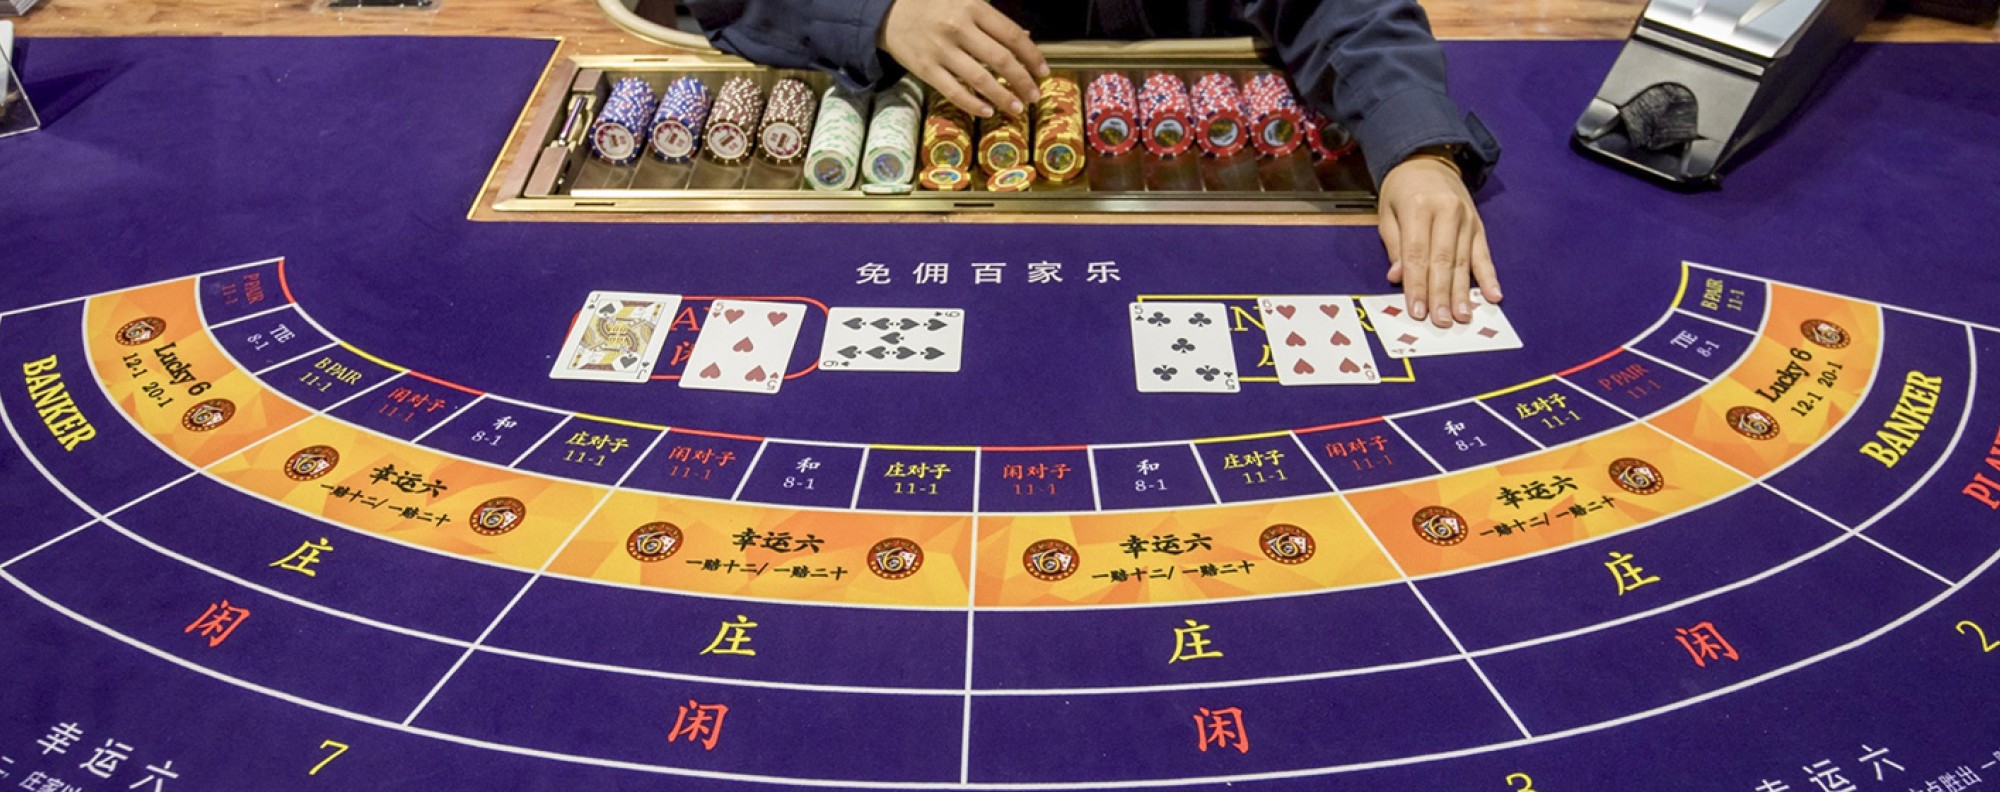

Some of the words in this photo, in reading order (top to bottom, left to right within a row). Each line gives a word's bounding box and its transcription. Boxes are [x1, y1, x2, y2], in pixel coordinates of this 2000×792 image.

[856, 261, 1122, 285] 免佣百家乐
[1702, 278, 1724, 303] PAIR
[1727, 289, 1745, 311] 11-1
[1134, 305, 1144, 315] 5
[247, 333, 269, 351] 8-1
[269, 323, 296, 344] TIE
[1669, 330, 1698, 349] TIE
[1696, 340, 1721, 358] 8-1
[122, 352, 149, 379] 12-1
[142, 381, 174, 408] 20-1
[153, 342, 197, 386] Lucky
[187, 381, 212, 397] 6
[299, 371, 332, 392] 11-1
[314, 356, 333, 370] B
[324, 361, 362, 386] PAIR
[1610, 363, 1649, 387] PAIR
[1755, 359, 1811, 404] Lucky
[1790, 347, 1813, 362] 6
[1225, 379, 1236, 390] 5
[1791, 392, 1823, 418] 12-1
[1818, 361, 1844, 388] 20-1
[23, 354, 97, 453] BANKER
[387, 386, 446, 413] 闲对子
[1515, 392, 1567, 419] 庄对子
[492, 416, 518, 430] 和
[1443, 420, 1467, 438] 和
[1541, 409, 1583, 430] 11-1
[1859, 370, 1943, 469] BANKER
[471, 431, 502, 447] 8-1
[565, 430, 630, 453] 庄对子
[1325, 434, 1390, 459] 闲对子
[1455, 436, 1488, 451] 8-1
[563, 450, 606, 467] 11-1
[667, 446, 737, 466] 闲对子
[796, 456, 822, 473] 和
[1137, 459, 1161, 476] 和
[1223, 449, 1286, 471] 庄对子
[369, 463, 449, 499] 幸运六
[884, 462, 952, 480] 庄对子
[1003, 463, 1072, 480] 闲对子
[1244, 469, 1288, 485] 11-1
[783, 476, 816, 491] 8-1
[894, 481, 939, 495] 11-1
[1134, 478, 1168, 493] 8-1
[1496, 475, 1578, 509] 幸运六
[388, 505, 451, 527] 一赔二十
[1555, 495, 1618, 520] 一赔二十
[732, 527, 825, 553] 幸运六
[1119, 533, 1213, 559] 幸运六
[269, 537, 334, 578] 庄
[1182, 560, 1255, 578] 一赔二十
[773, 565, 849, 582] 一赔二十
[1605, 551, 1661, 596] 庄
[184, 599, 251, 648] 闲
[699, 615, 759, 657] 庄
[1168, 619, 1224, 665] 庄
[1675, 620, 1740, 668] 闲
[1955, 620, 2000, 653] 2
[667, 699, 730, 752] 闲
[1193, 706, 1251, 754] 闲
[36, 722, 179, 792] 幸运六
[308, 739, 349, 777] 7
